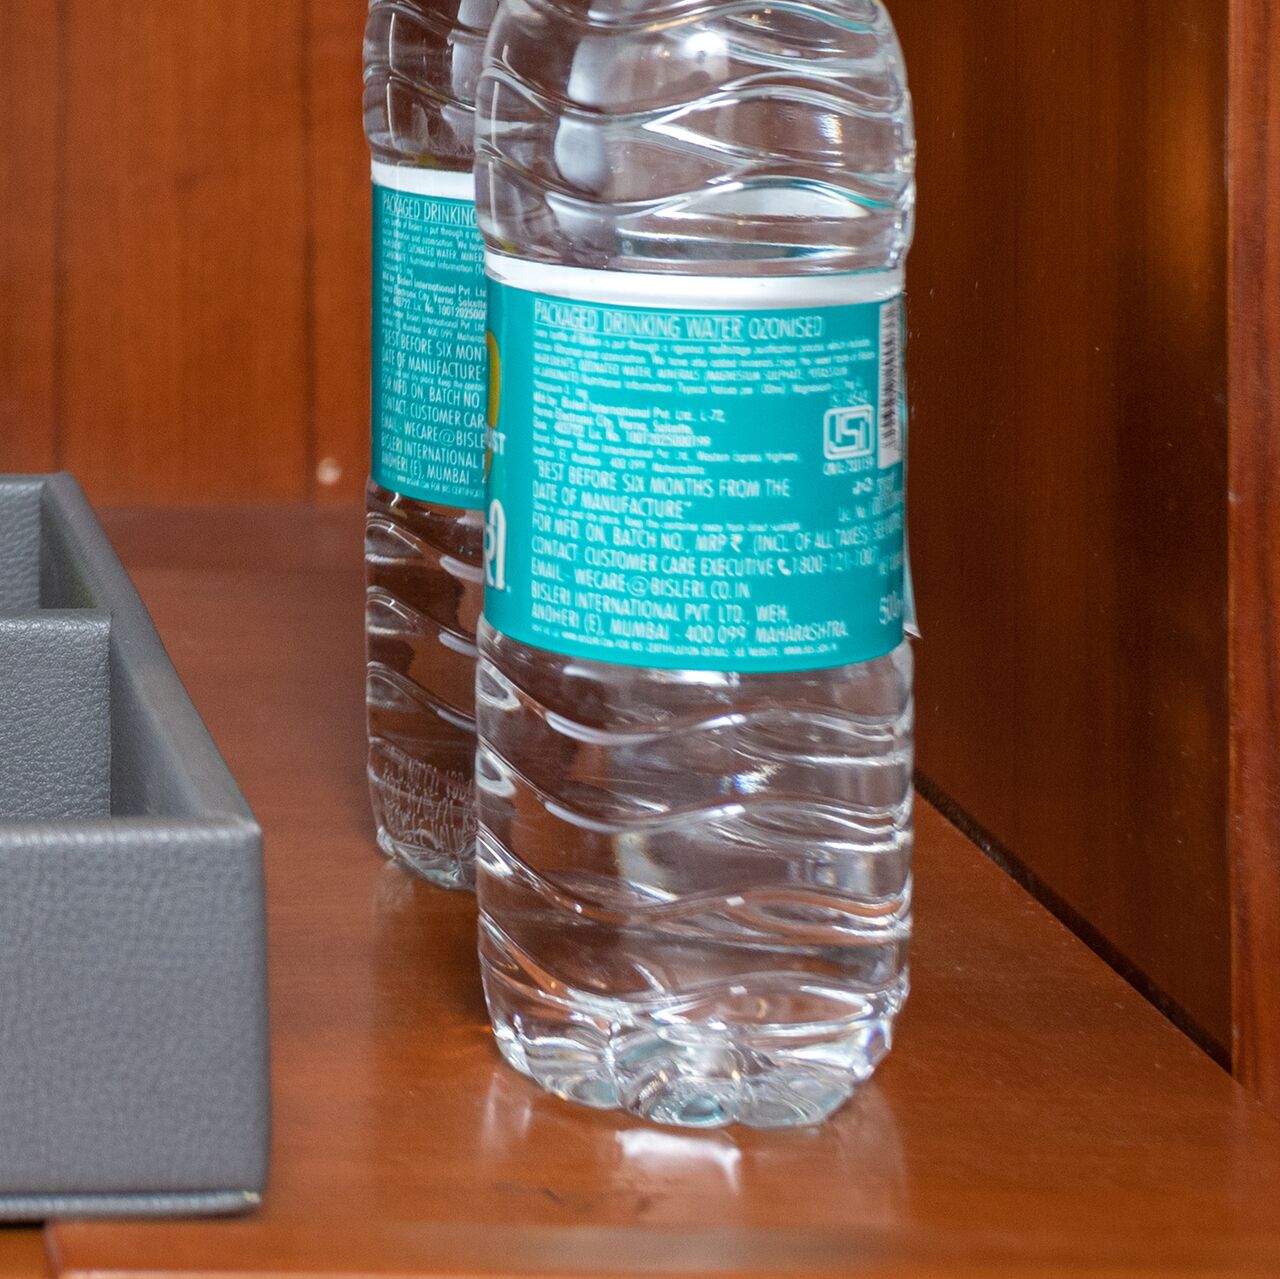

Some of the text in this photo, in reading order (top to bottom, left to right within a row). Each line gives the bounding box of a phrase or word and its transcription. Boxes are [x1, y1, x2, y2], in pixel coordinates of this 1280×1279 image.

[383, 193, 420, 218] PACKAGED
[535, 300, 598, 332] PACKAGED
[603, 311, 681, 339] DRINKING
[686, 316, 742, 339] WATER
[749, 316, 823, 340] OZONISED
[401, 334, 432, 355] BEFORE
[436, 341, 452, 358] SIX
[429, 386, 460, 406] BATCH
[410, 403, 461, 425] CUSTOMER
[404, 441, 479, 469] INTERNATIONAL
[427, 464, 469, 485] MUMBAI
[568, 465, 617, 491] BEFORE
[622, 473, 645, 493] SIX
[650, 477, 714, 498] MONTHS
[719, 479, 760, 497] FROM
[764, 478, 790, 497] THE
[533, 480, 558, 503] DATE
[561, 486, 577, 506] OF
[532, 512, 552, 532] FOR
[613, 527, 657, 548] BATCH
[695, 534, 726, 552] MRP
[794, 532, 811, 551] OF
[584, 546, 658, 571] CUSTOMER
[661, 555, 696, 576] CARE
[700, 557, 775, 577] EXECUTIVE
[531, 580, 571, 606] BISLERI
[575, 591, 680, 621] INTERNATIONAL
[531, 602, 579, 628] ANDHERI
[610, 618, 670, 641] MUMBAI
[685, 625, 714, 643] 400
